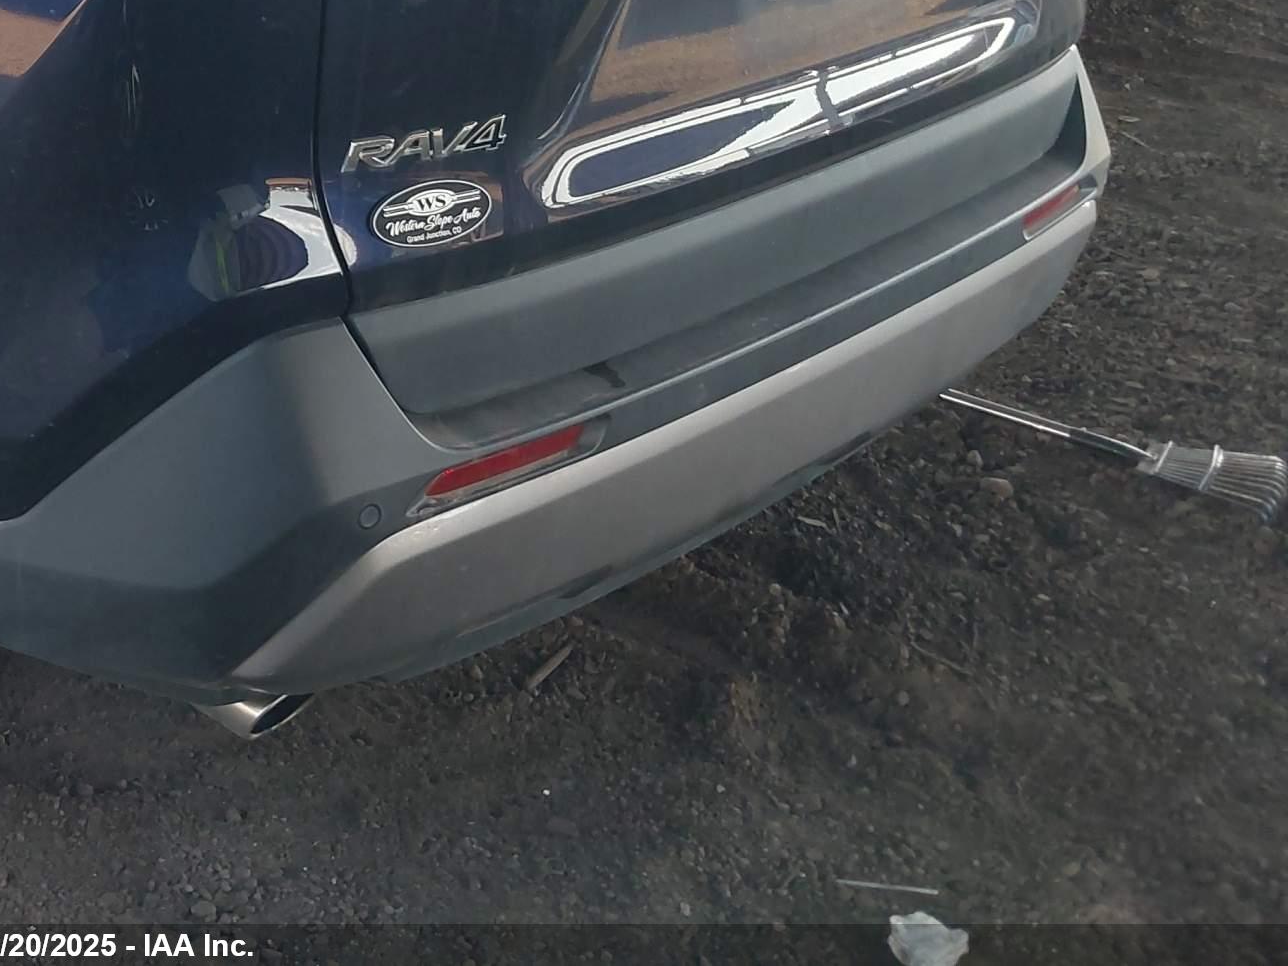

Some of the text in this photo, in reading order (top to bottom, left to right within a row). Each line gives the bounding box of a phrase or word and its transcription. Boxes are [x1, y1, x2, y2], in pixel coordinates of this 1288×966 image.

[341, 114, 507, 173] RAV4
[416, 194, 448, 212] WS
[385, 207, 481, 237] Western Slope Auto
[452, 225, 462, 234] CO
